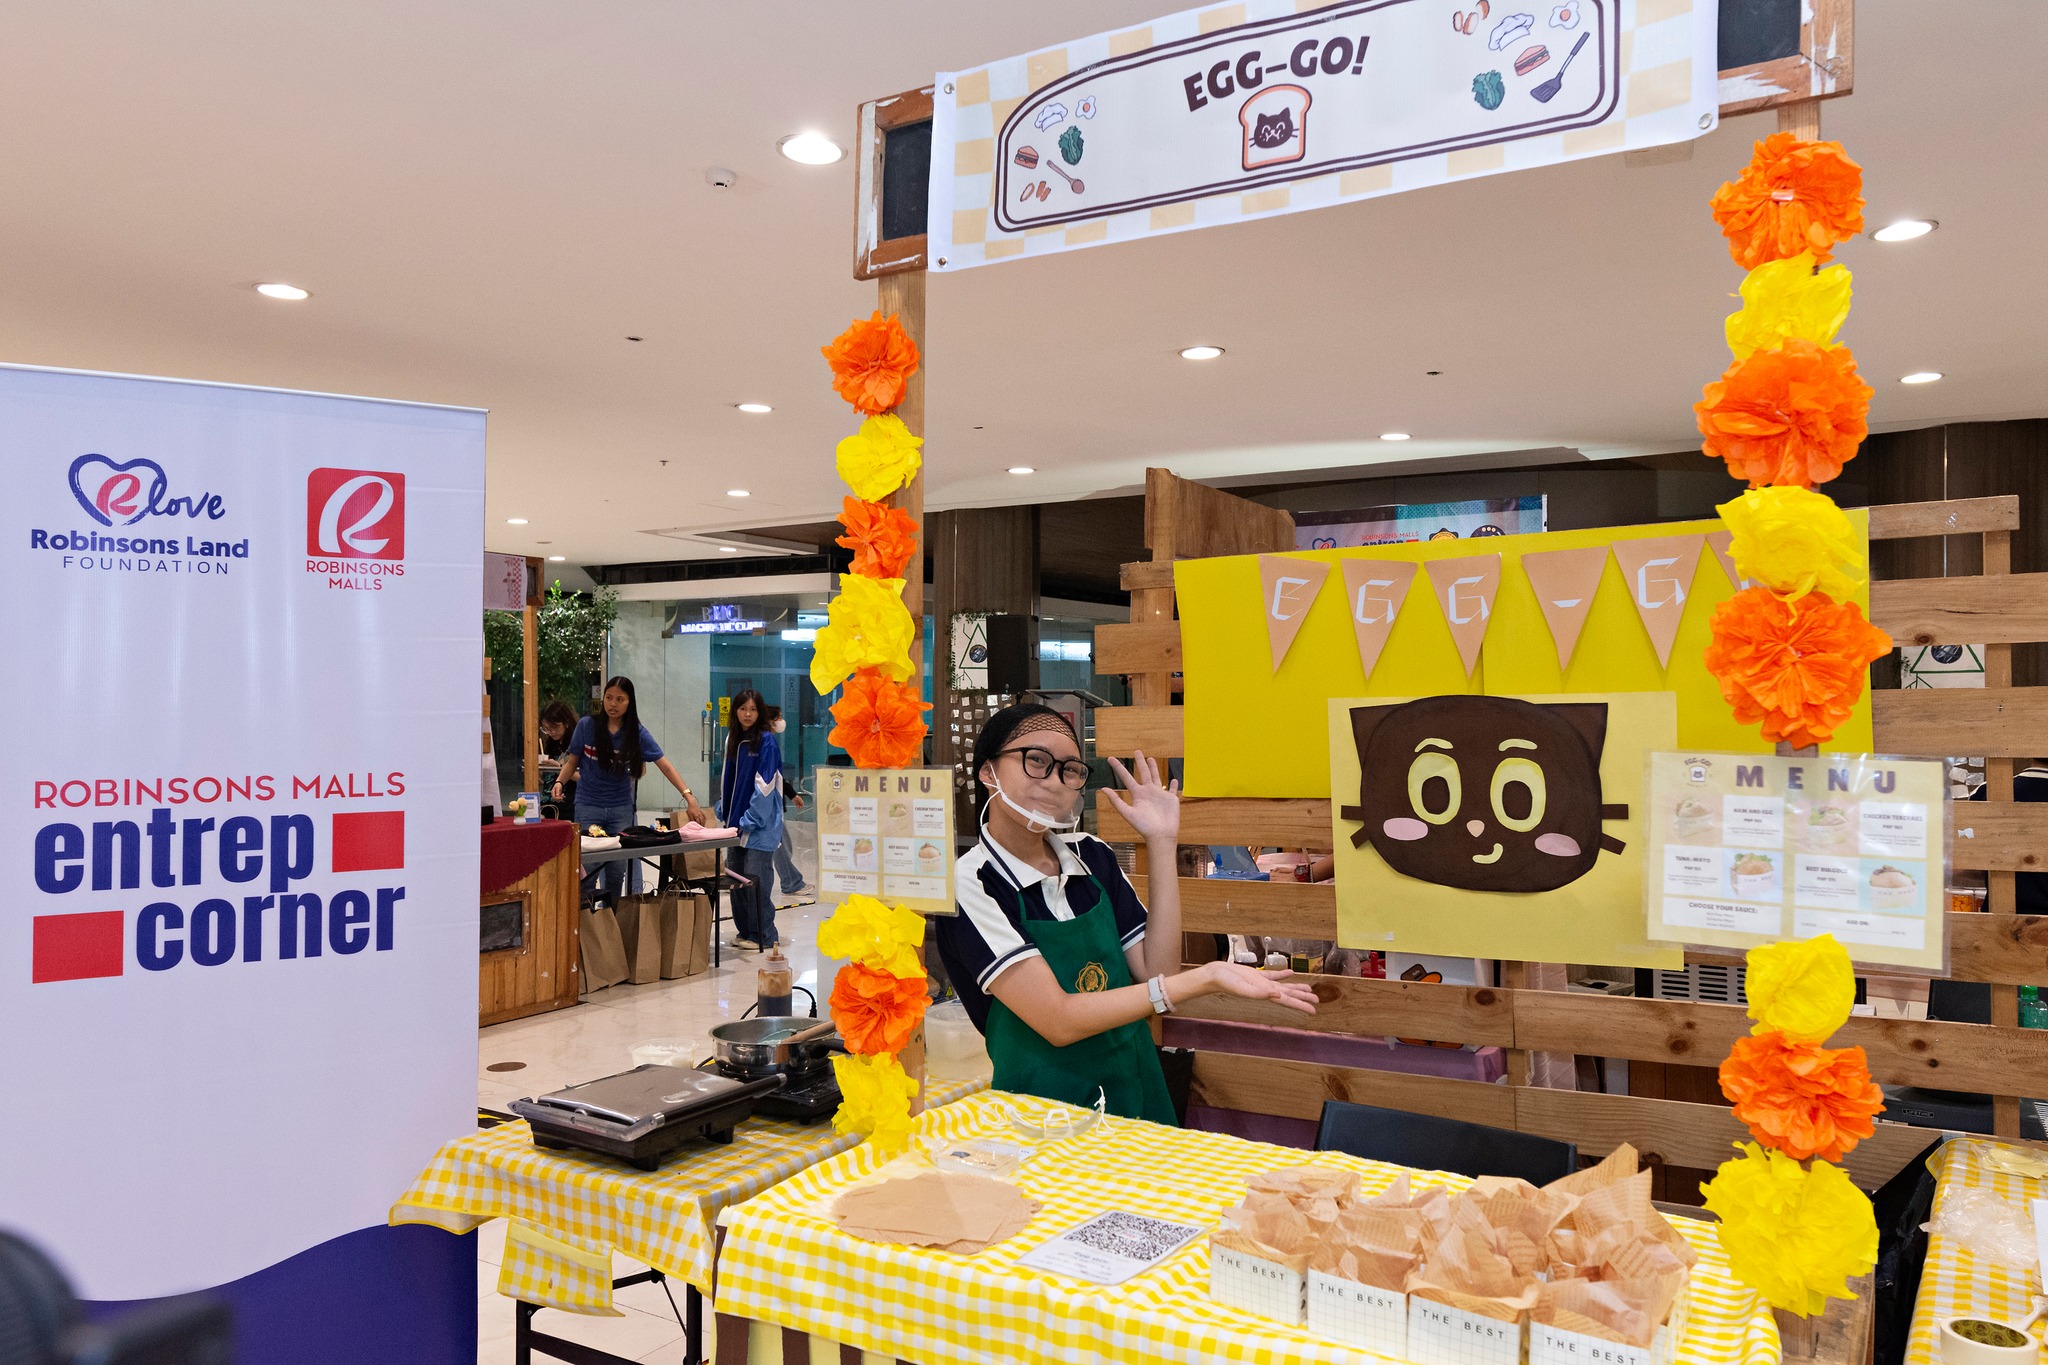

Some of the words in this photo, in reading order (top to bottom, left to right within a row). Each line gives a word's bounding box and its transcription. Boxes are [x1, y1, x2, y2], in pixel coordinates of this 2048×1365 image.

[31, 528, 180, 555] Robinsons
[187, 535, 249, 559] Land
[1362, 532, 1398, 541] ROBINSONS
[1400, 530, 1419, 538] MALLS
[63, 555, 229, 575] FOUNDATION
[306, 559, 405, 577] ROBINSONS
[328, 577, 383, 591] MALLS
[34, 775, 276, 809] ROBINSONS
[292, 771, 406, 800] MALLS
[34, 807, 314, 895] entrep
[1688, 902, 1714, 910] CHOOSE
[136, 886, 406, 971] corner
[1220, 1254, 1241, 1269] THE
[1252, 1265, 1285, 1281] BEST
[1320, 1282, 1344, 1297] THE
[1357, 1293, 1393, 1309] BEST
[1422, 1309, 1450, 1325] THE
[1464, 1321, 1504, 1340] BEST
[1546, 1336, 1576, 1353] THE
[1593, 1348, 1636, 1365] BEST
